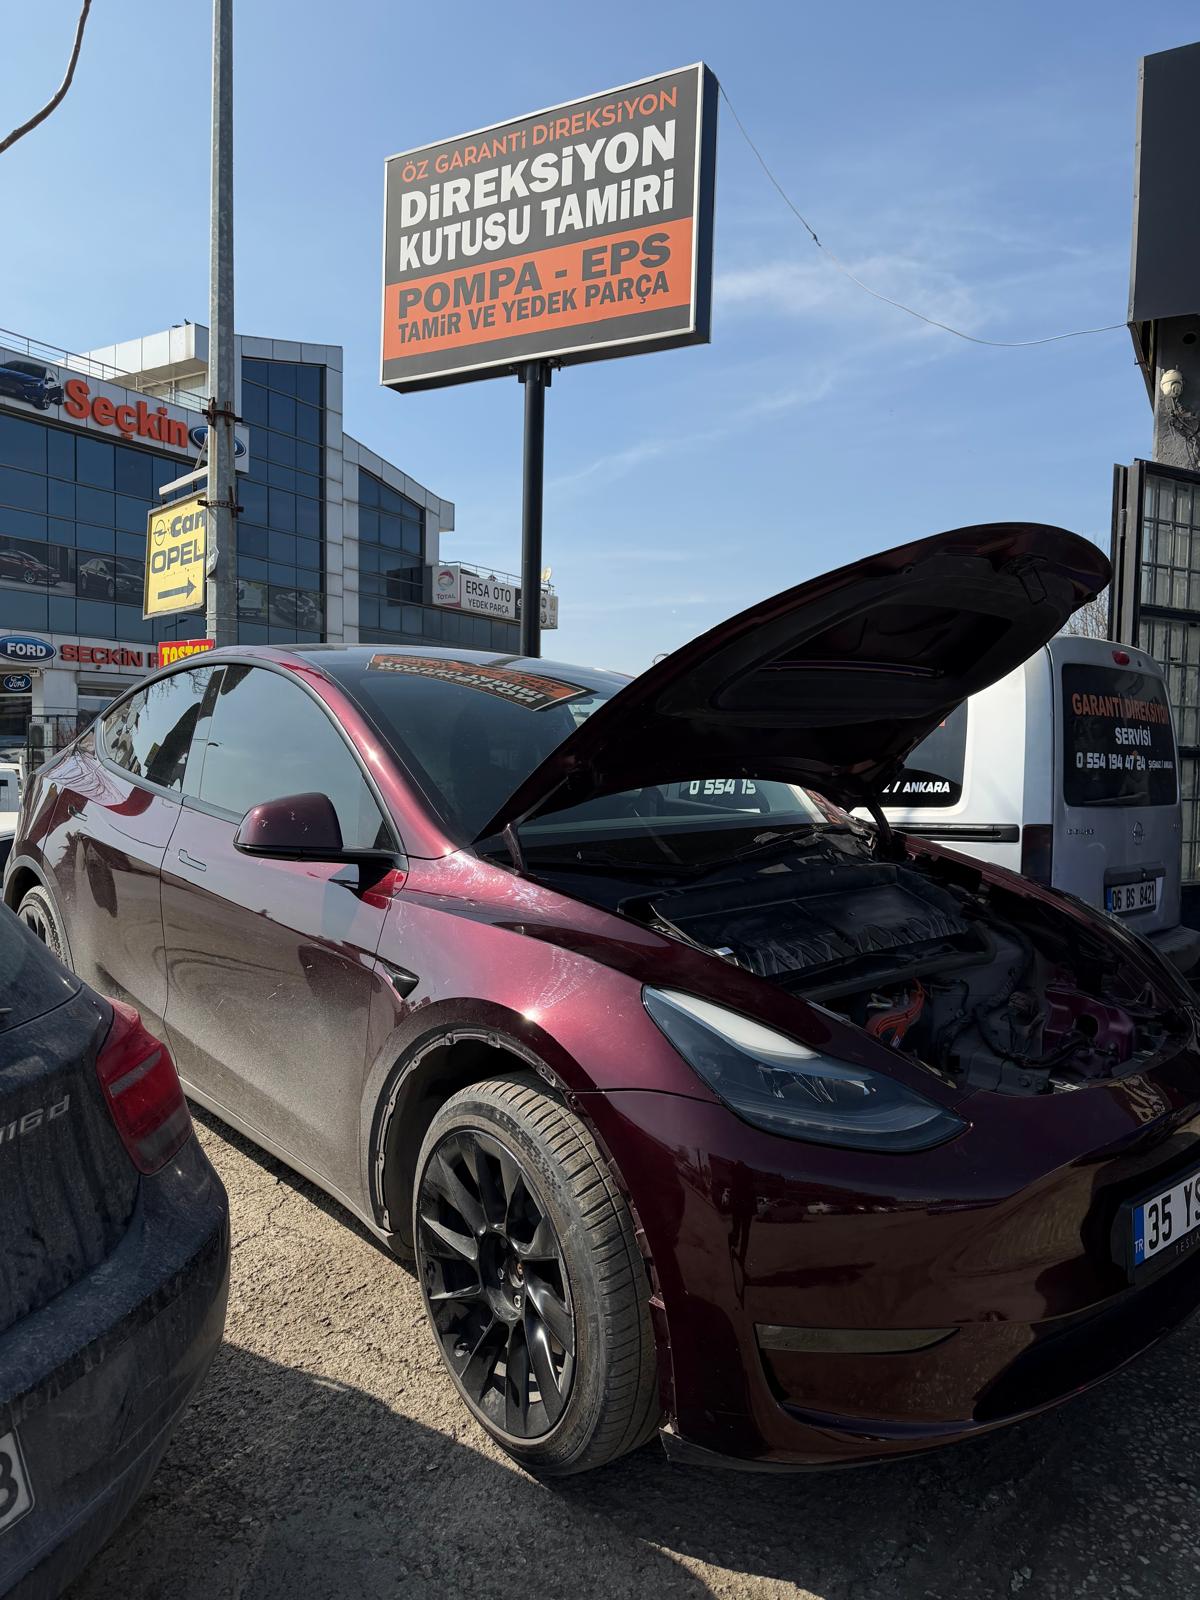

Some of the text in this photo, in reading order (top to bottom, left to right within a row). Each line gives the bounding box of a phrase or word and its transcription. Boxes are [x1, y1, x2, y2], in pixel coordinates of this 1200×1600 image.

[401, 160, 429, 183] ÖZ
[400, 204, 531, 272] KUTUSU
[398, 260, 543, 319] POMPA
[581, 232, 671, 282] EPS
[468, 305, 497, 330] VE
[502, 288, 577, 323] YEDEK
[585, 270, 670, 307] PARÇA
[64, 378, 189, 448] Seçkin
[151, 538, 206, 574] OPEL
[465, 580, 490, 598] ERSA
[493, 586, 511, 603] OTO
[467, 598, 509, 614] YEDEK PARÇA
[6, 642, 47, 657] FORD
[1076, 752, 1084, 768] 0
[1086, 752, 1106, 769] 554
[1109, 753, 1123, 770] 194
[1125, 754, 1135, 770] 47
[1136, 755, 1146, 771] 24
[689, 780, 700, 795] 0
[703, 778, 736, 795] 554
[902, 781, 951, 793] ANKARA
[1112, 884, 1155, 910] 06 BS 8421
[1148, 1194, 1172, 1250] 35
[1134, 1238, 1144, 1254] TR
